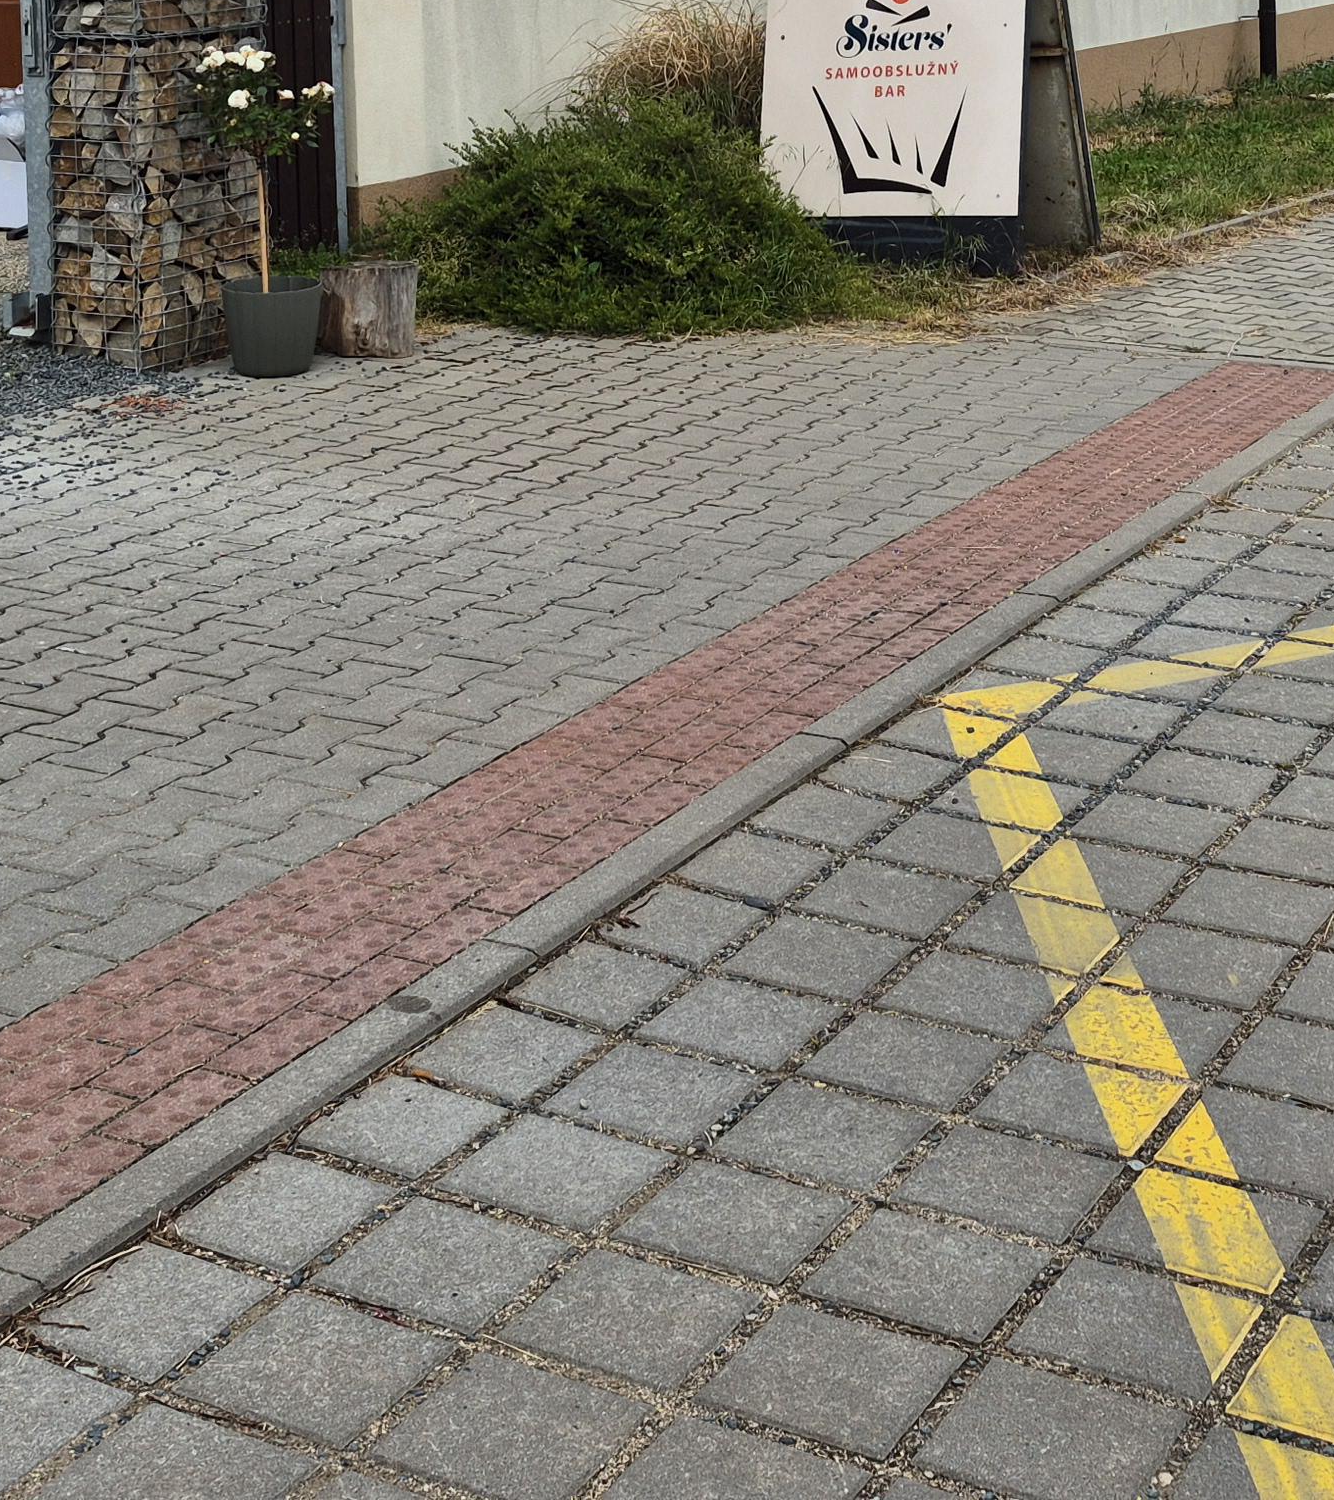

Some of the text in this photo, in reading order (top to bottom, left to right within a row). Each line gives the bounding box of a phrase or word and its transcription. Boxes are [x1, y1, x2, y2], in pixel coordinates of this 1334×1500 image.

[836, 14, 953, 58] Sisters'
[825, 60, 959, 80] SAMOOBSLUŽNÝ
[874, 85, 906, 98] BAR
